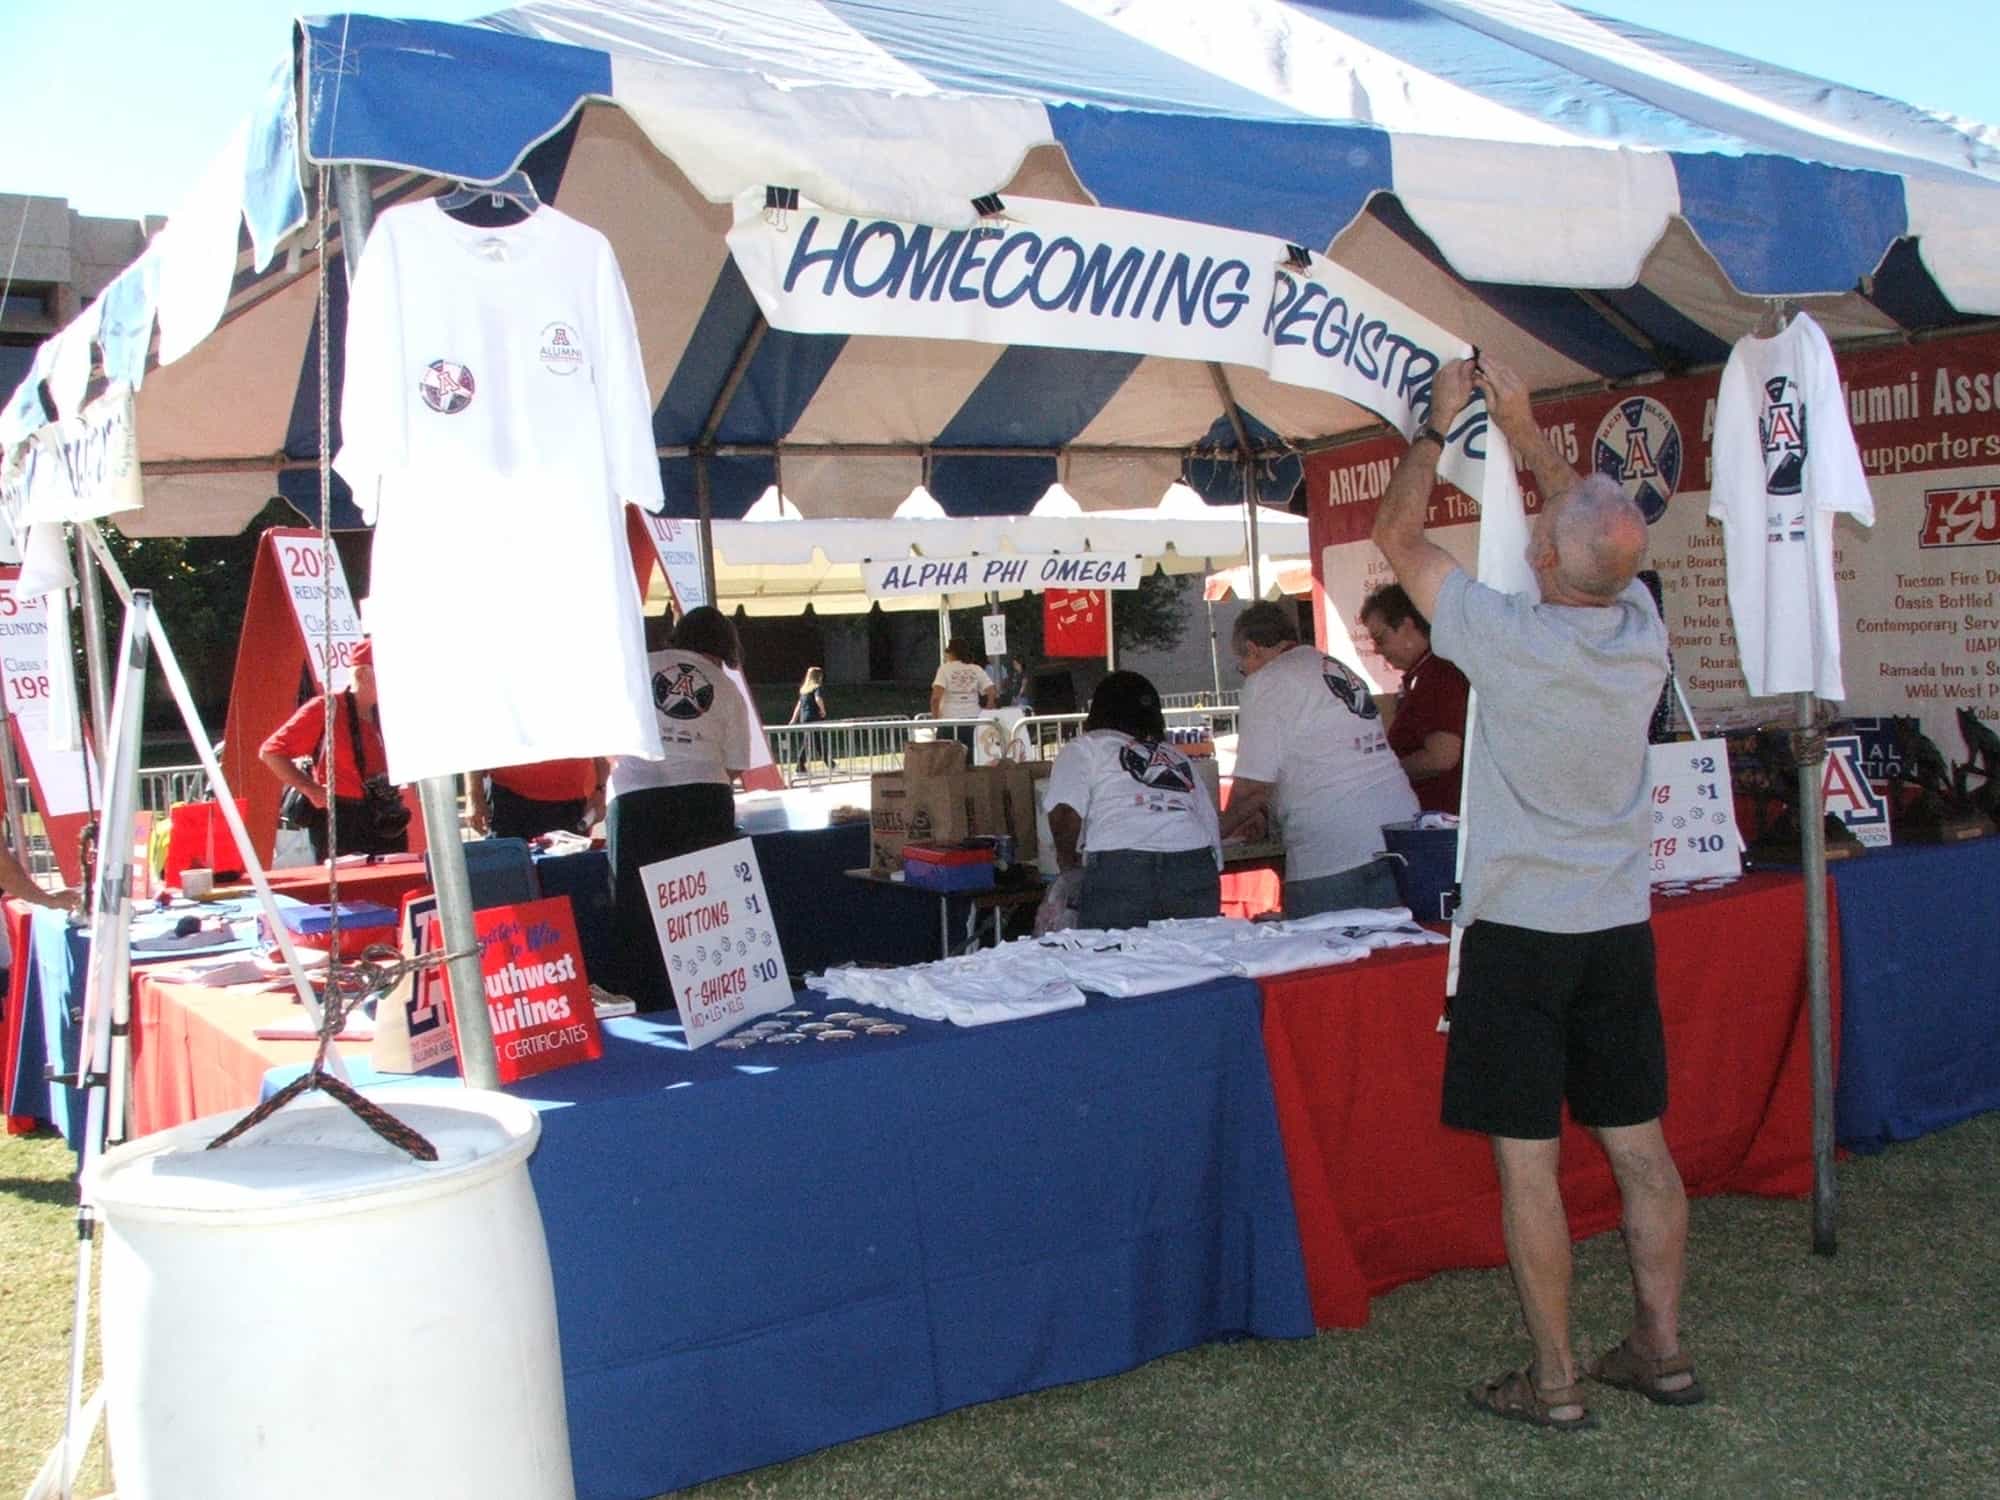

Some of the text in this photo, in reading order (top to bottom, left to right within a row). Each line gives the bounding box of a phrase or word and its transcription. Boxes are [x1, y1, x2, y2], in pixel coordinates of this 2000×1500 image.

[783, 215, 1251, 329] HOMECOMING
[1843, 371, 1919, 426] lumni
[1767, 402, 1801, 451] A
[1863, 431, 2000, 474] upporters
[1328, 456, 1400, 508] ARIZON
[1444, 493, 1480, 525] Tha
[881, 557, 1128, 590] ALPHA PHI OMEGA
[1687, 555, 1727, 570] Boar
[294, 585, 346, 600] REUNON
[1694, 574, 1727, 589] Tran
[1896, 573, 1944, 588] Tucson
[1951, 570, 1979, 586] Fire
[1895, 592, 1993, 610] Oasis Bottled
[1856, 617, 1957, 635] Contemporary
[1879, 662, 1936, 677] Ramada
[1941, 662, 1964, 676] Inn
[1904, 684, 1938, 698] Wild
[1943, 683, 1982, 698] West
[1689, 756, 1716, 773] $2
[1696, 783, 1718, 800] $1
[1820, 737, 1886, 825] A
[1687, 834, 1724, 853] $10
[657, 861, 752, 909] BEADS $2
[666, 893, 761, 943] BUTTONS $1
[485, 953, 577, 999] uthwest
[684, 958, 778, 1011] T-SHIRTS $10
[504, 1023, 589, 1061] CERTIFICATES
